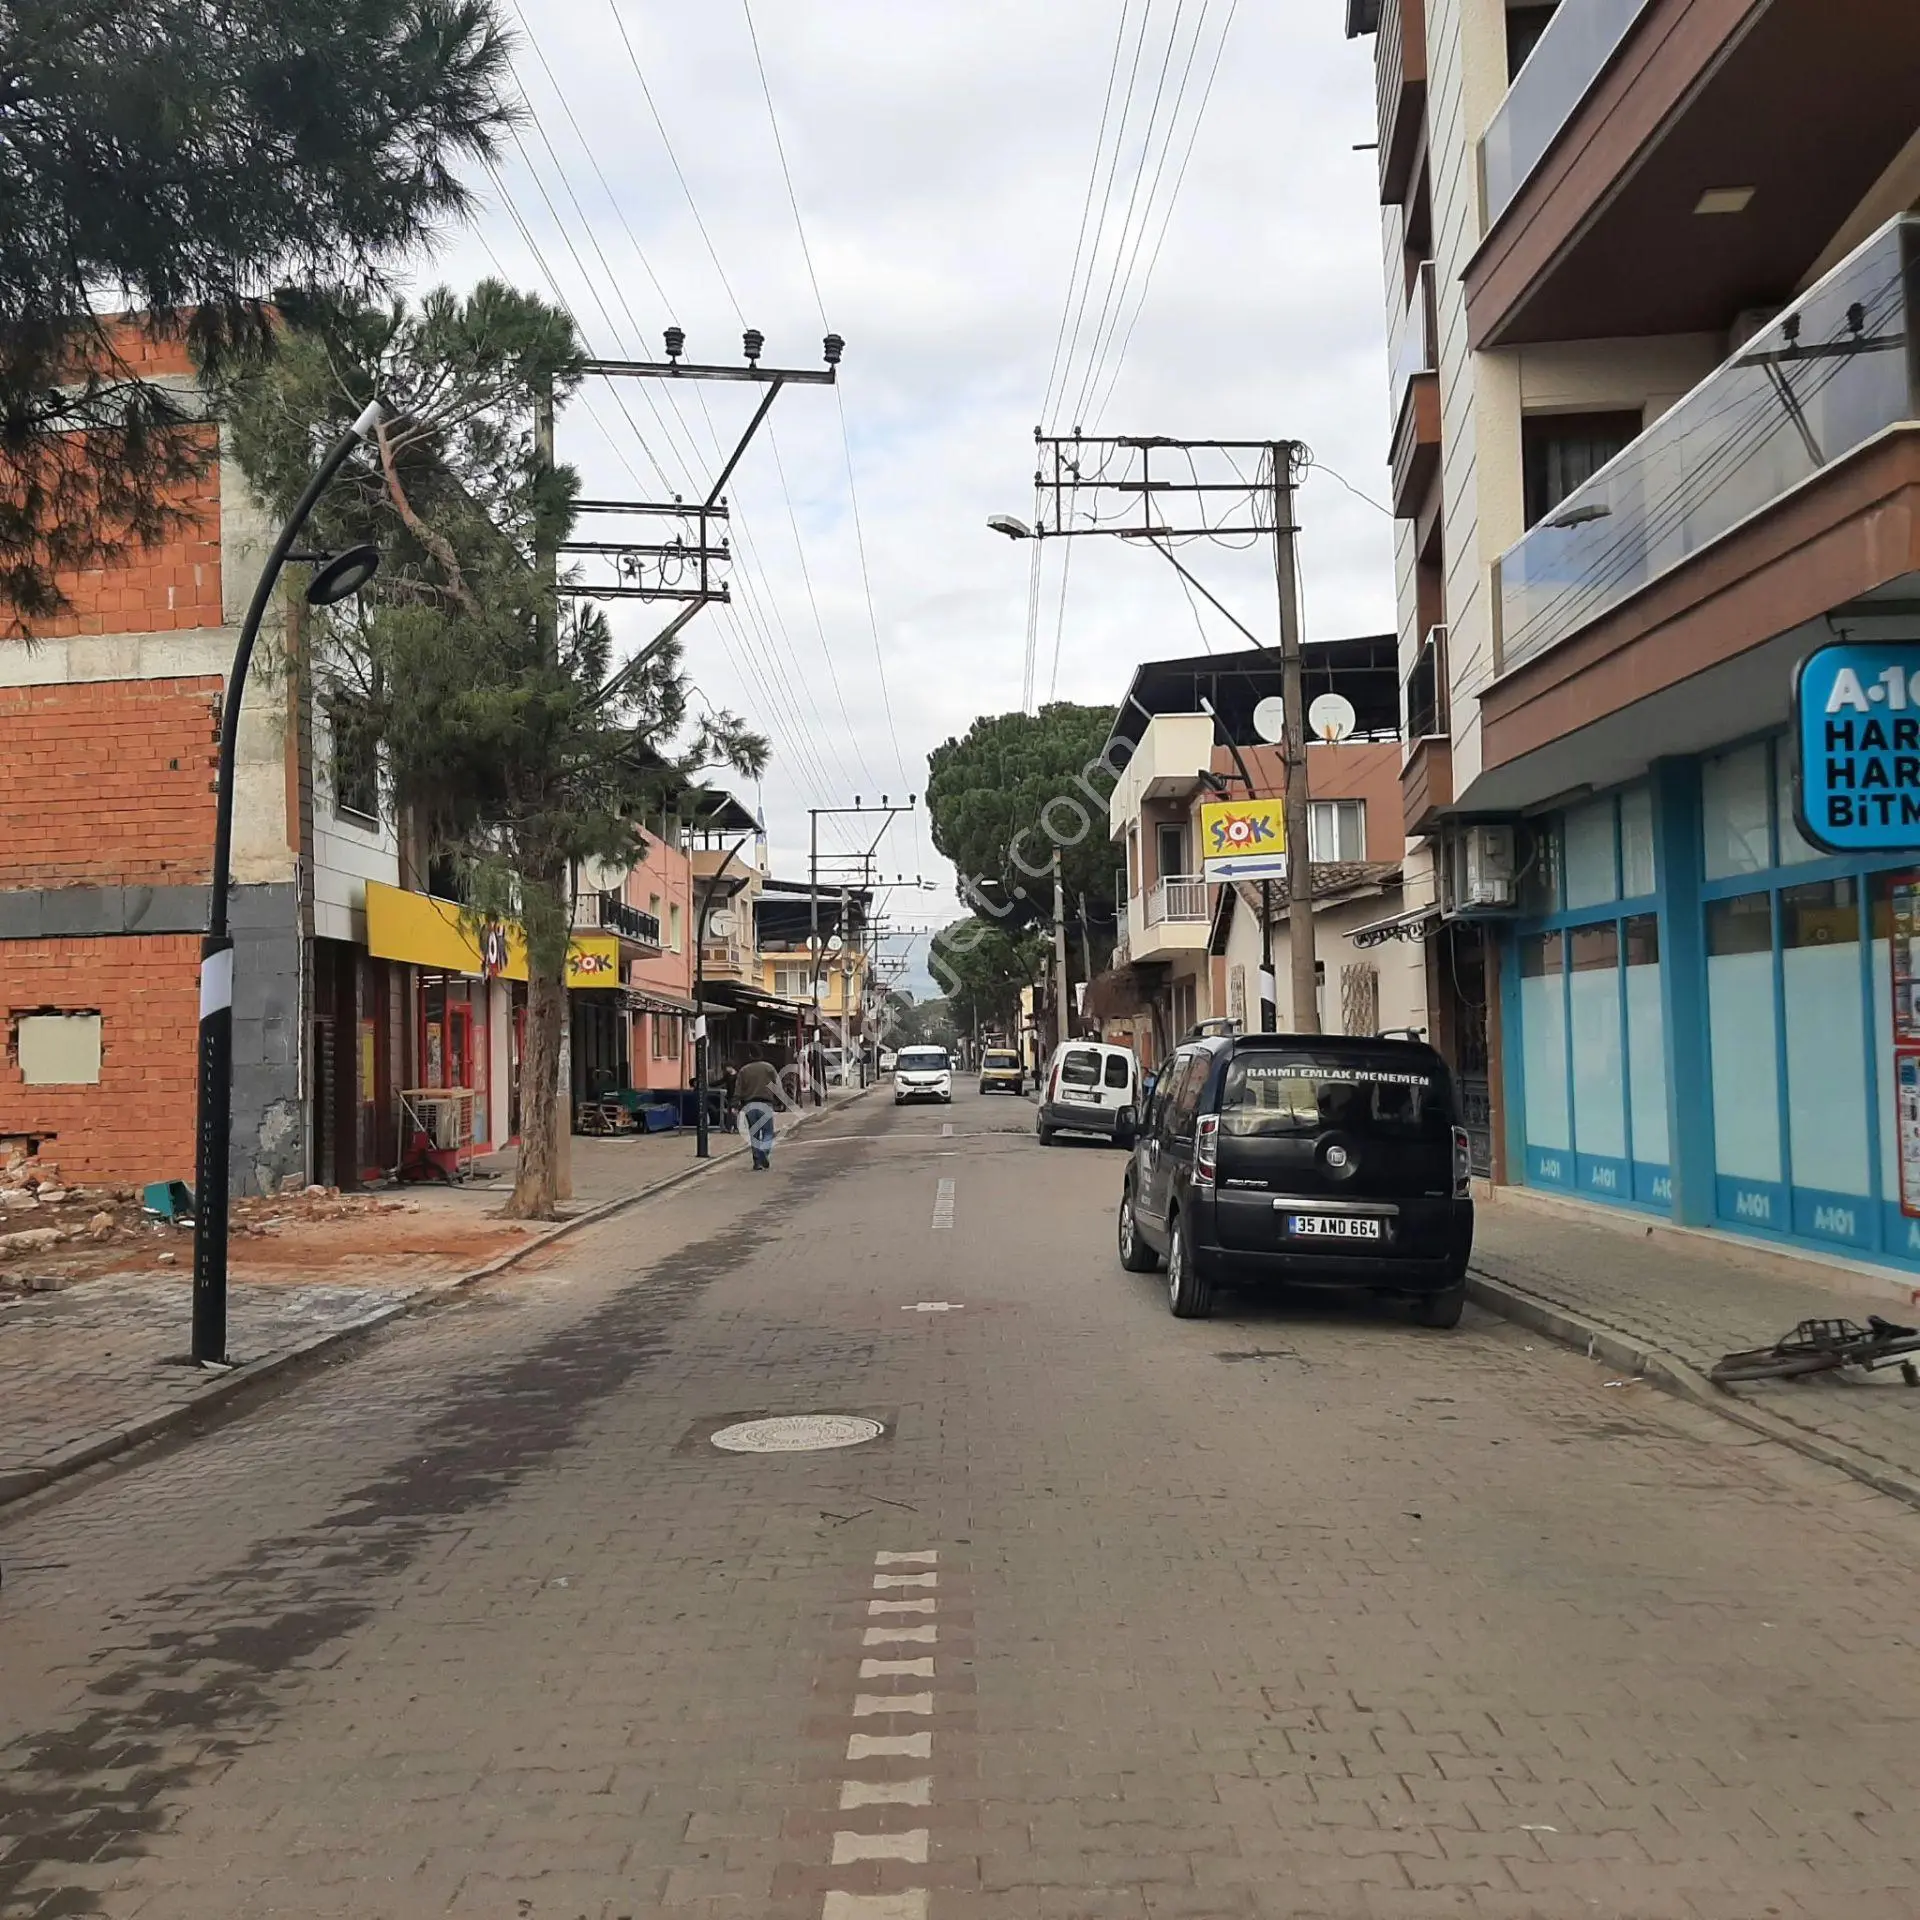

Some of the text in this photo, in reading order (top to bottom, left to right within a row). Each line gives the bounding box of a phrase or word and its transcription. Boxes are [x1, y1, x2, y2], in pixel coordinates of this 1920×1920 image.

[1210, 814, 1275, 852] ŞOK
[1300, 1068, 1351, 1080] EMLAK
[1355, 1071, 1430, 1086] MENEMEN
[1298, 1217, 1315, 1232] 35
[1320, 1219, 1346, 1234] AND
[1350, 1220, 1377, 1236] 664
